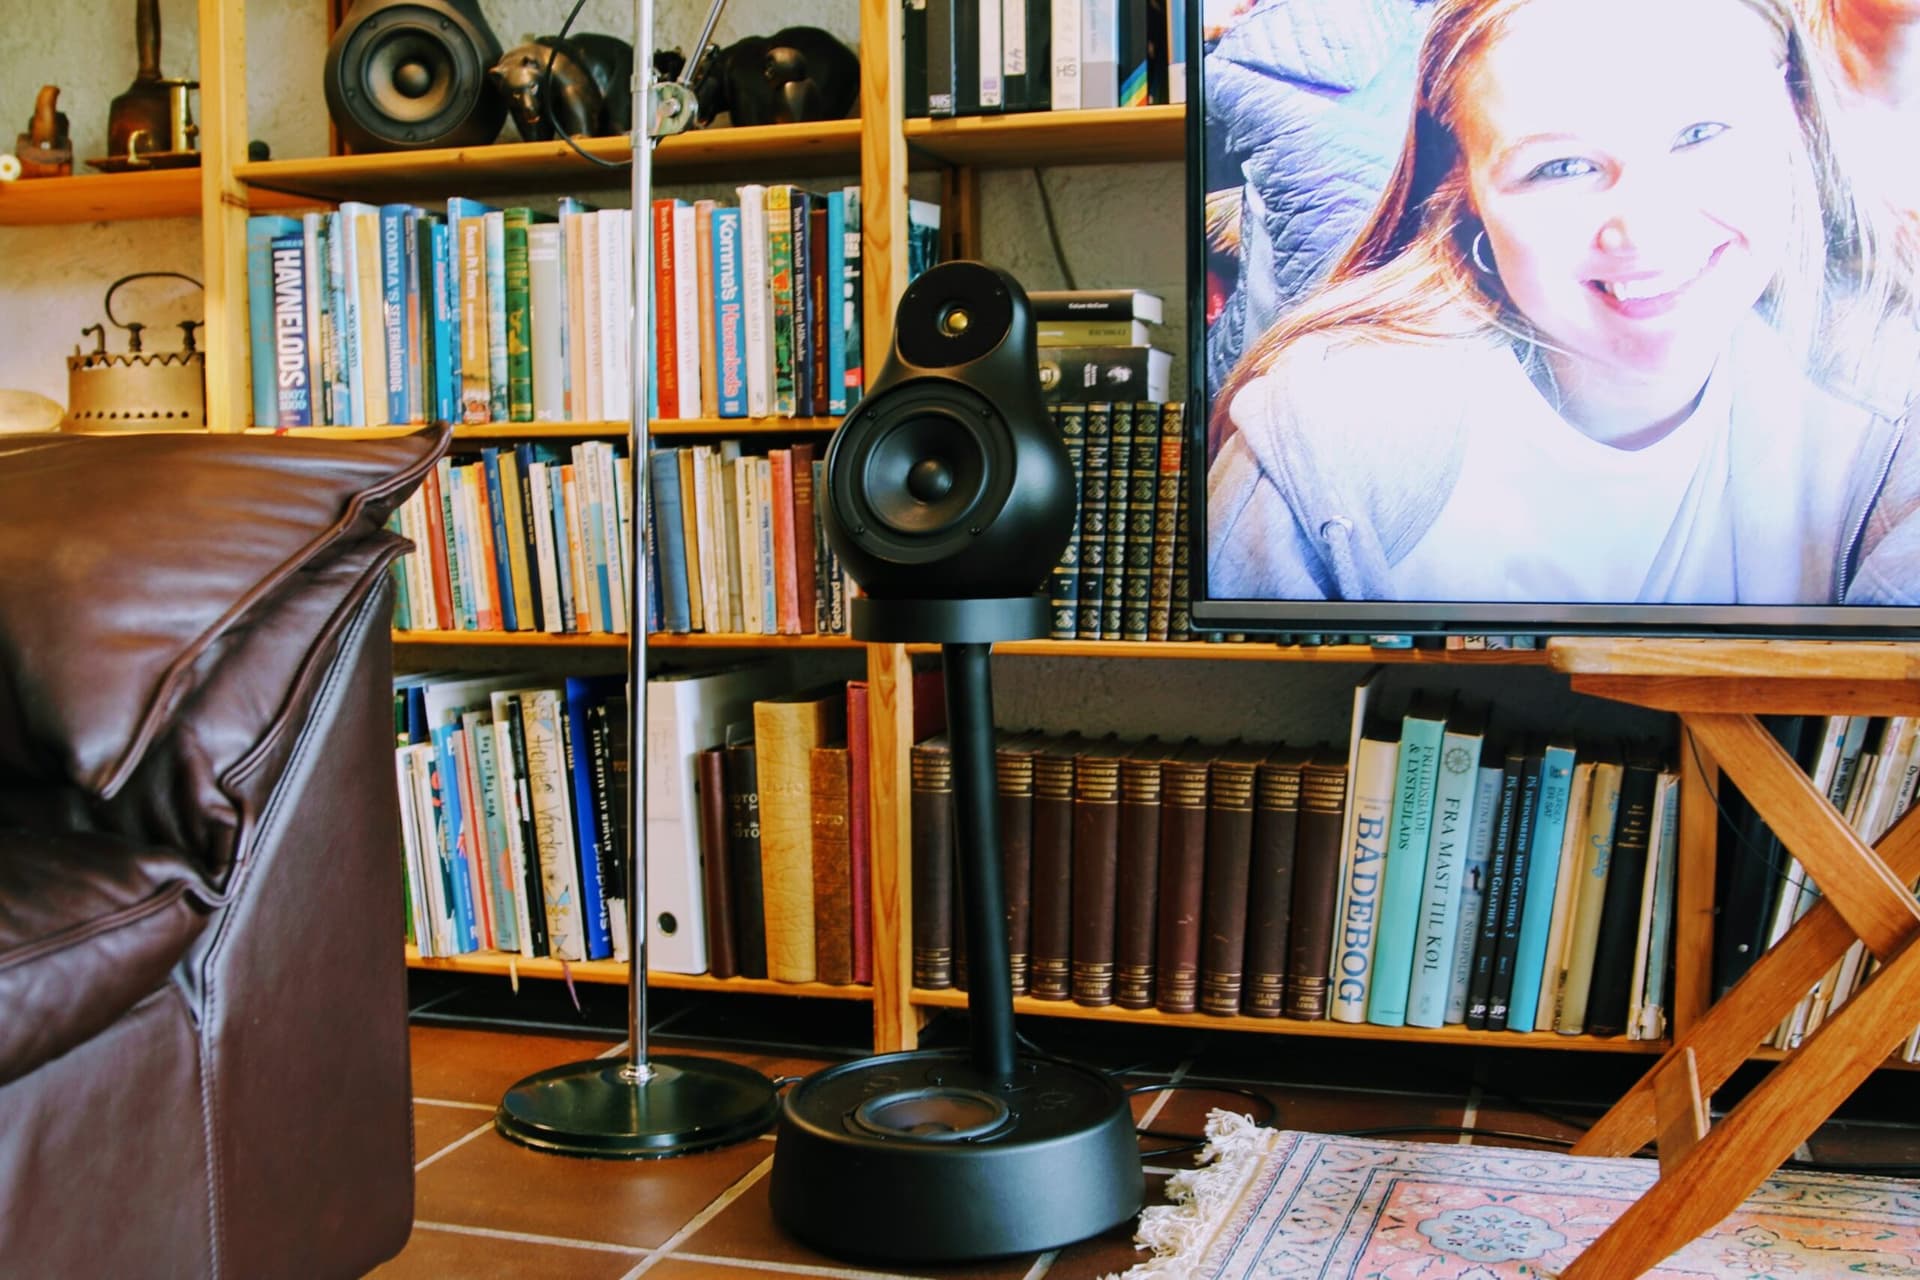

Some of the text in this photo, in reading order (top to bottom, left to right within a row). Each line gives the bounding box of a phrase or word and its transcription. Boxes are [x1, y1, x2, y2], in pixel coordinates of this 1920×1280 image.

[384, 216, 400, 302] KOMMA'S
[719, 214, 739, 300] Komma's
[274, 249, 305, 387] HAVNELODS
[722, 304, 741, 397] Havnelods
[830, 581, 842, 630] Gebhard
[482, 735, 493, 754] Tag
[484, 775, 496, 794] Tag
[486, 796, 496, 818] Von
[592, 728, 612, 851] KINDER AUS ALLER WELT
[1398, 743, 1418, 850] & LYSTSEJLADS
[1415, 746, 1435, 836] FRITIDSBÅDE
[1423, 797, 1461, 976] FRA MAST TIL KØL
[1493, 854, 1505, 875] MED
[1513, 854, 1525, 875] MED
[1338, 813, 1387, 1006] BÅDEBOG
[1485, 876, 1502, 928] GALATHEA
[1506, 876, 1522, 928] GALATHEA
[1457, 919, 1475, 985] NORDPOLEN
[1470, 1004, 1486, 1014] JP
[1490, 1005, 1507, 1015] JP
